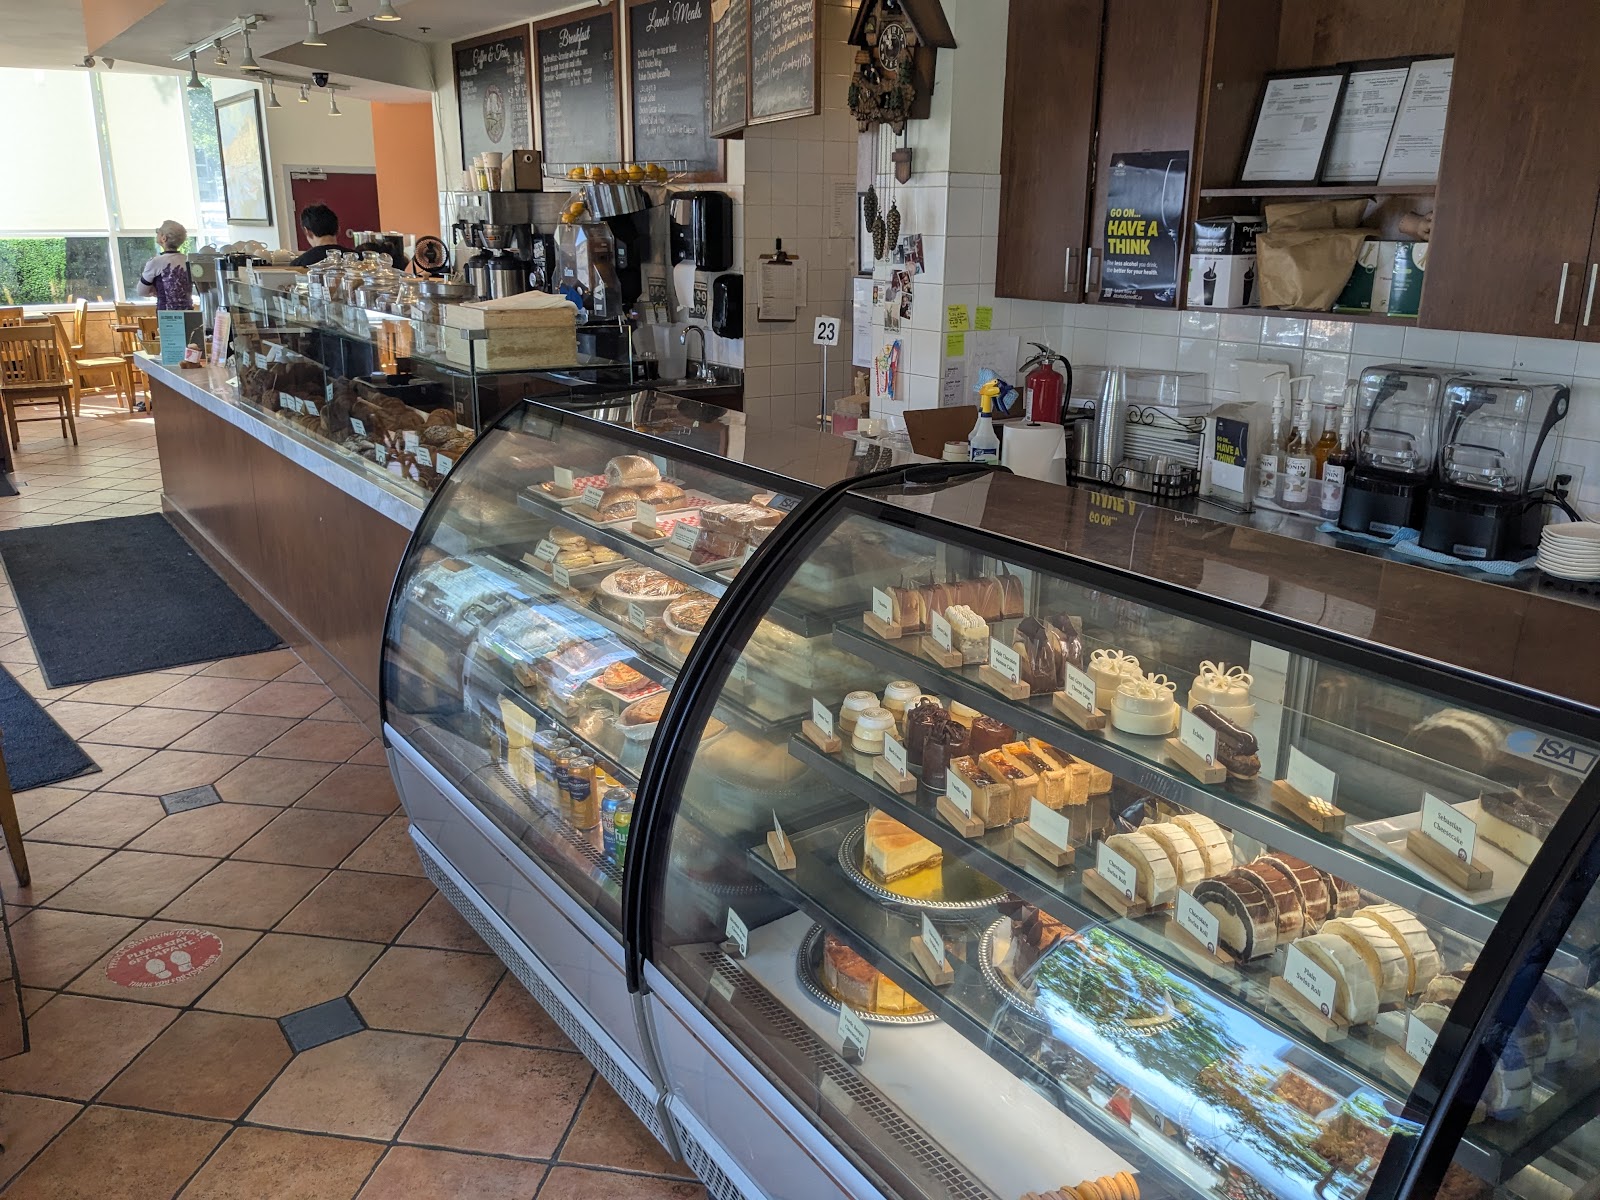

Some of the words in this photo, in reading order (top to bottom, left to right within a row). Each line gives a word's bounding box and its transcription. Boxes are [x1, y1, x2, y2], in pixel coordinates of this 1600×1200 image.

[646, 7, 669, 33] Lunch
[672, 2, 702, 24] Meals
[559, 25, 590, 49] Breakfast
[1110, 208, 1122, 217] GO
[1108, 220, 1146, 236] HAVE
[1148, 221, 1158, 236] A
[1108, 239, 1150, 255] THINK
[817, 322, 835, 340] 23
[1217, 442, 1234, 454] HAVE
[1235, 446, 1240, 456] A
[1216, 452, 1235, 465] THINK
[1003, 654, 1017, 665] Chocolate
[1536, 738, 1576, 764] ISA
[1434, 822, 1463, 845] Cheesecake
[1107, 867, 1118, 879] Swiss
[1188, 916, 1199, 929] Swiss
[1200, 926, 1208, 937] Roll
[1189, 908, 1208, 928] Chocolate
[127, 944, 163, 959] PLEASE
[164, 935, 188, 948] STAY
[154, 940, 195, 957] APART
[1304, 968, 1317, 982] Plain
[1296, 972, 1310, 987] Swiss
[1311, 984, 1320, 996] Roll
